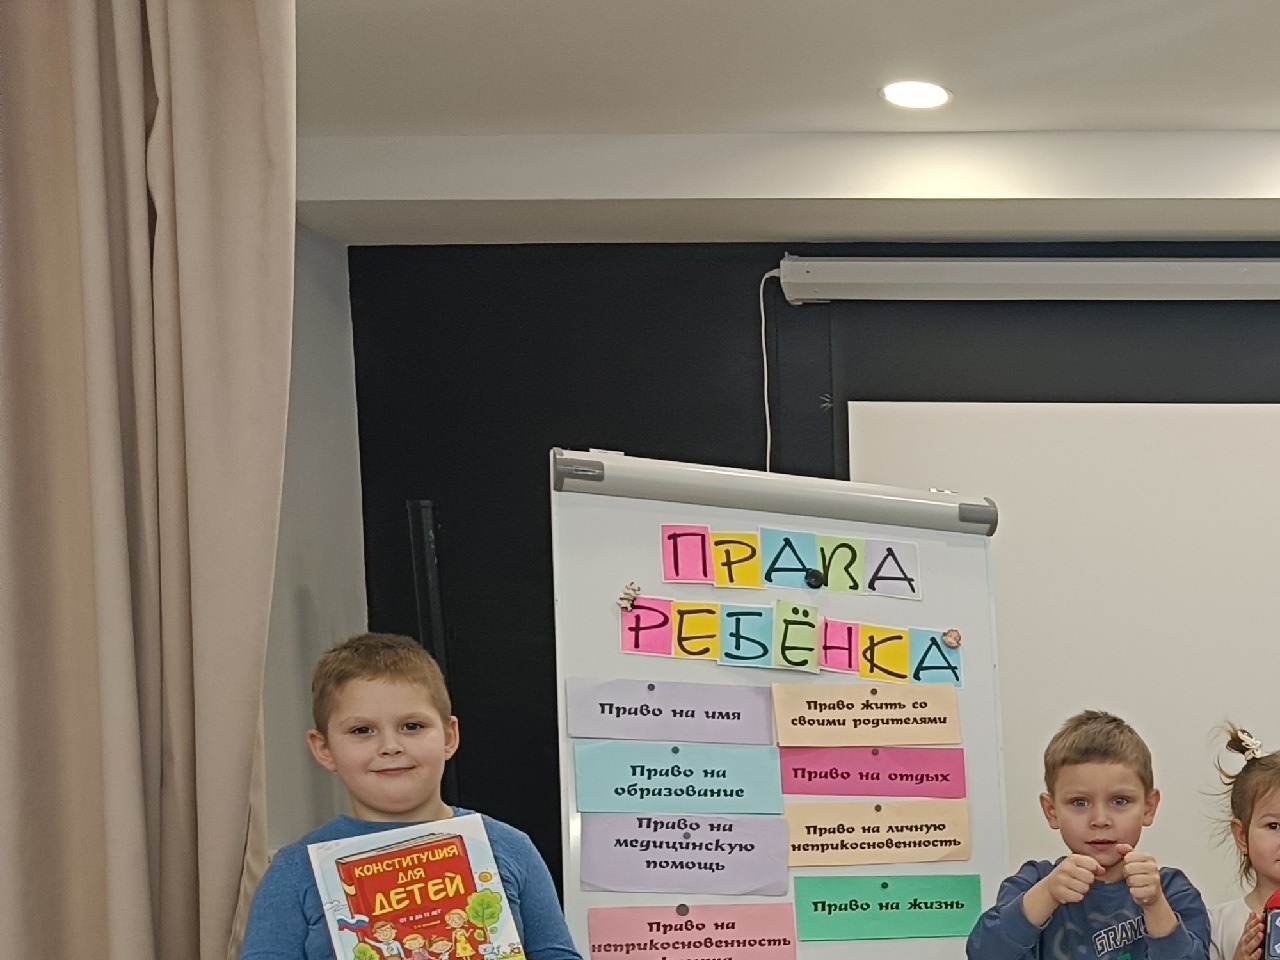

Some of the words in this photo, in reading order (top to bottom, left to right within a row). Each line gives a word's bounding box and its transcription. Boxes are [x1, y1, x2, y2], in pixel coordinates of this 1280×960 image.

[667, 532, 916, 593] ПРАВА
[627, 606, 960, 682] РЕБЁНКА
[598, 701, 663, 719] Право
[670, 707, 696, 719] на
[704, 708, 742, 721] имя
[805, 700, 855, 713] Право
[861, 700, 906, 711] жить
[911, 700, 928, 709] со
[790, 715, 847, 727] своими
[852, 714, 948, 729] родителями
[629, 764, 694, 780] Право
[702, 767, 727, 778] на
[792, 767, 853, 784] Право
[859, 771, 881, 781] на
[887, 772, 950, 784] отдых
[613, 784, 745, 801] образование
[637, 817, 701, 833] Право
[709, 820, 733, 832] на
[805, 824, 856, 838] Право
[862, 824, 880, 834] на
[887, 821, 946, 835] личную
[613, 837, 755, 853] медицинскую
[790, 837, 961, 854] неприкосновенность
[354, 845, 458, 878] КОНСТИТУЦИЯ
[645, 857, 725, 872] помощь
[397, 868, 425, 884] ДЛЯ
[372, 872, 465, 916] ДЕТЕЙ
[812, 899, 871, 914] Право
[879, 899, 900, 911] на
[907, 898, 964, 911] жизнь
[647, 920, 706, 934] Право
[714, 920, 736, 930] на
[591, 936, 790, 954] неприкосновенность
